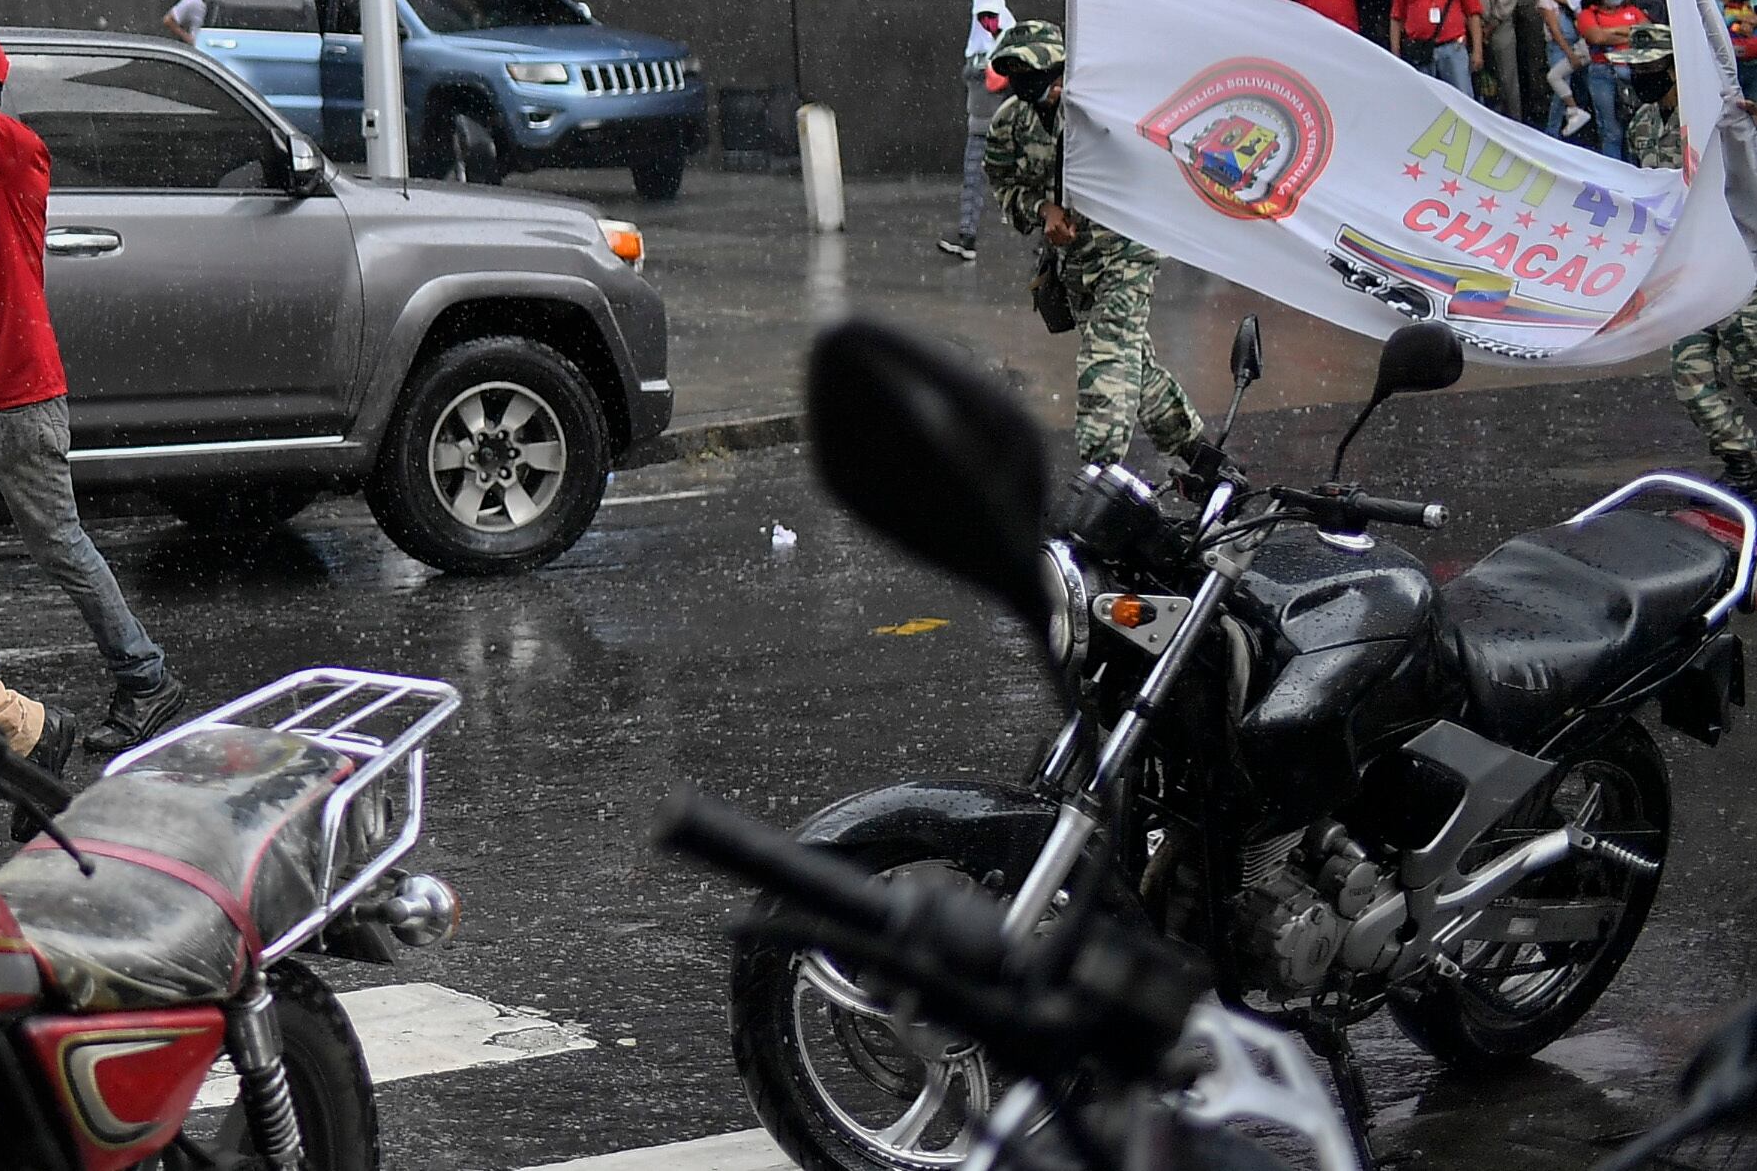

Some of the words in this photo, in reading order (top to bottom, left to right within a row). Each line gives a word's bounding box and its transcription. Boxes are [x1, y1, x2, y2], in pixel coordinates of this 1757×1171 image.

[1227, 76, 1305, 113] BOLIVARIANA
[1302, 111, 1316, 129] DE
[1402, 197, 1628, 298] CHACAO
